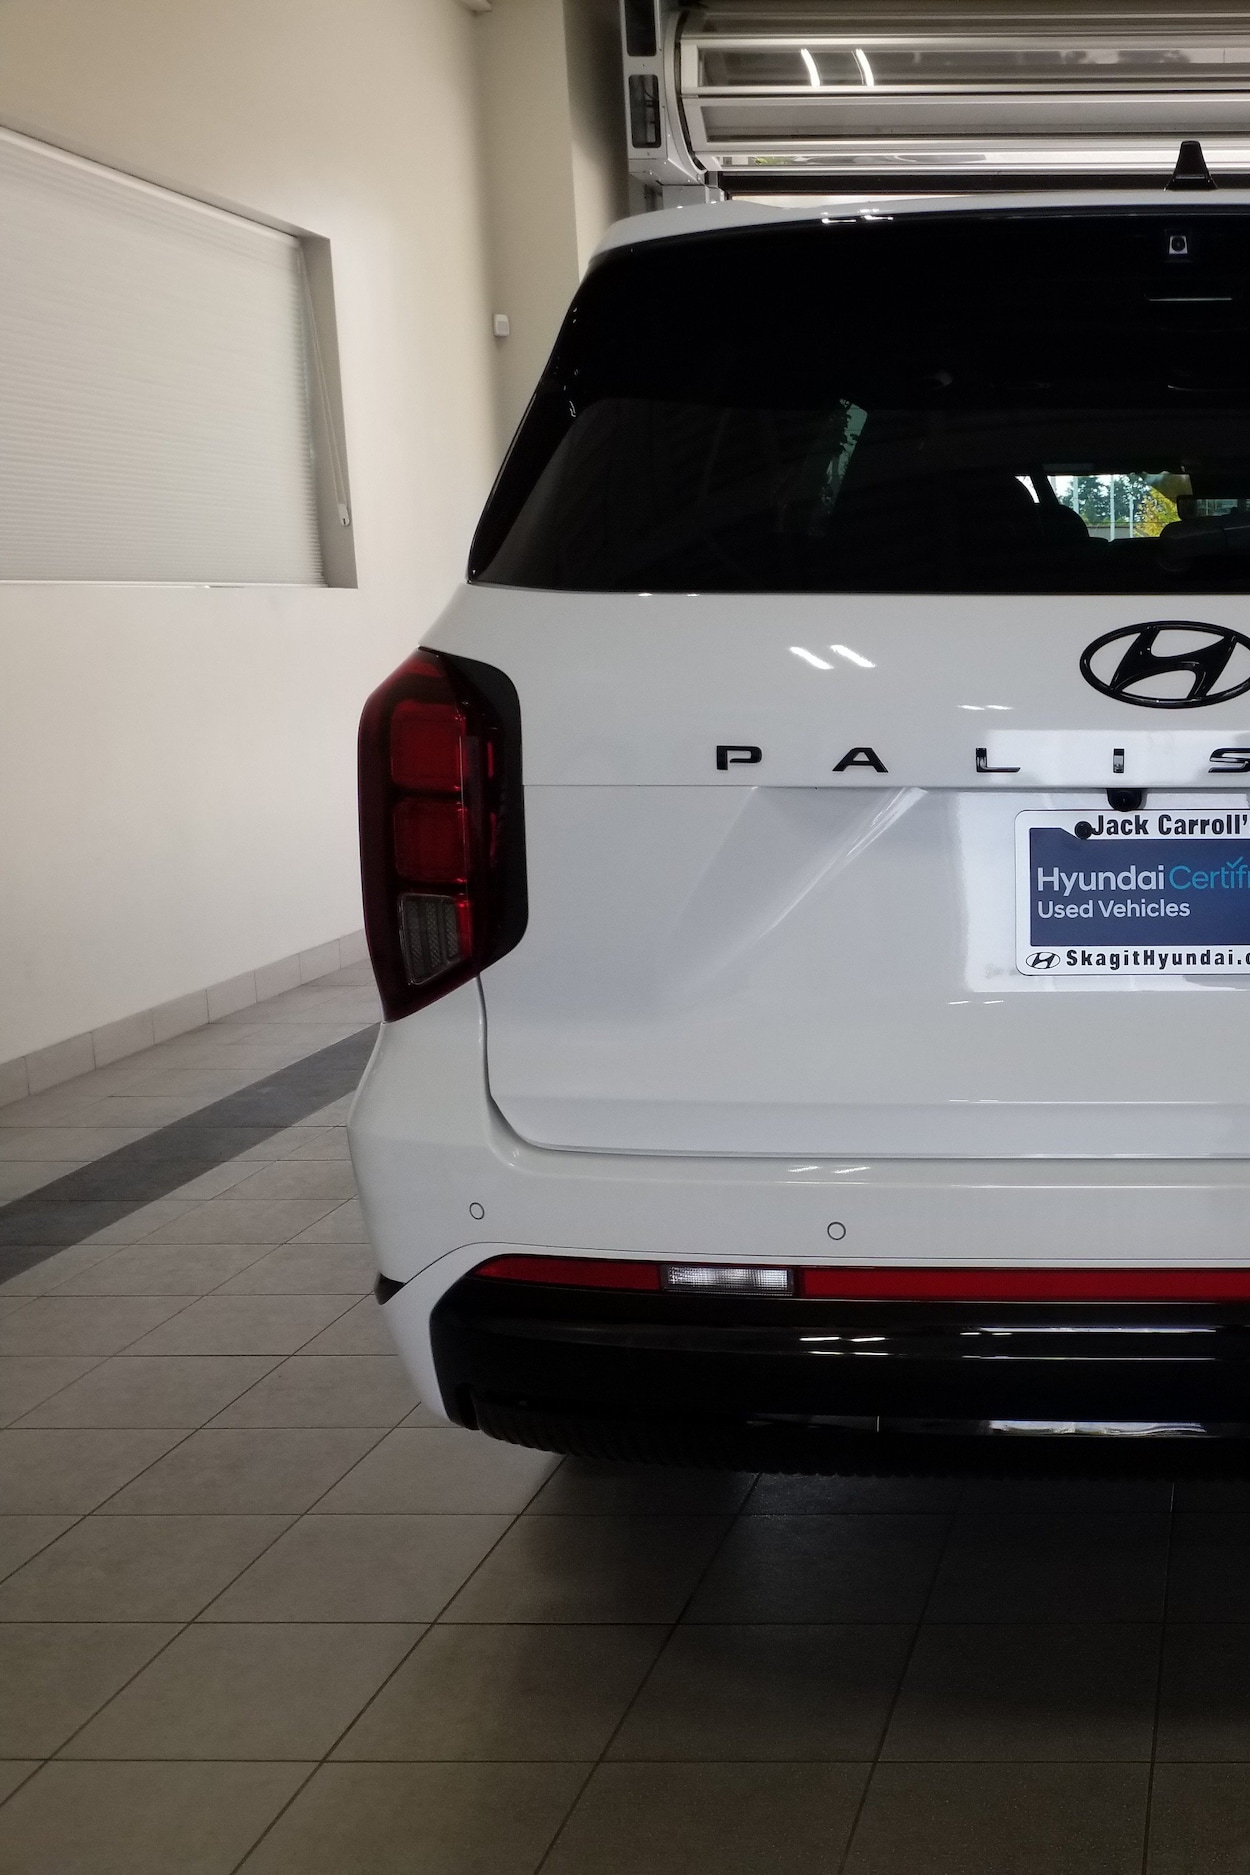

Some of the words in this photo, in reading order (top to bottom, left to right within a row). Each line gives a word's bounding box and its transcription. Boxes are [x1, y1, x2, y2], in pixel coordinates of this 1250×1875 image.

[1092, 814, 1149, 836] Jack
[1037, 864, 1165, 896] Hyundai
[1037, 900, 1094, 918] Used
[1098, 898, 1191, 917] Vehicles
